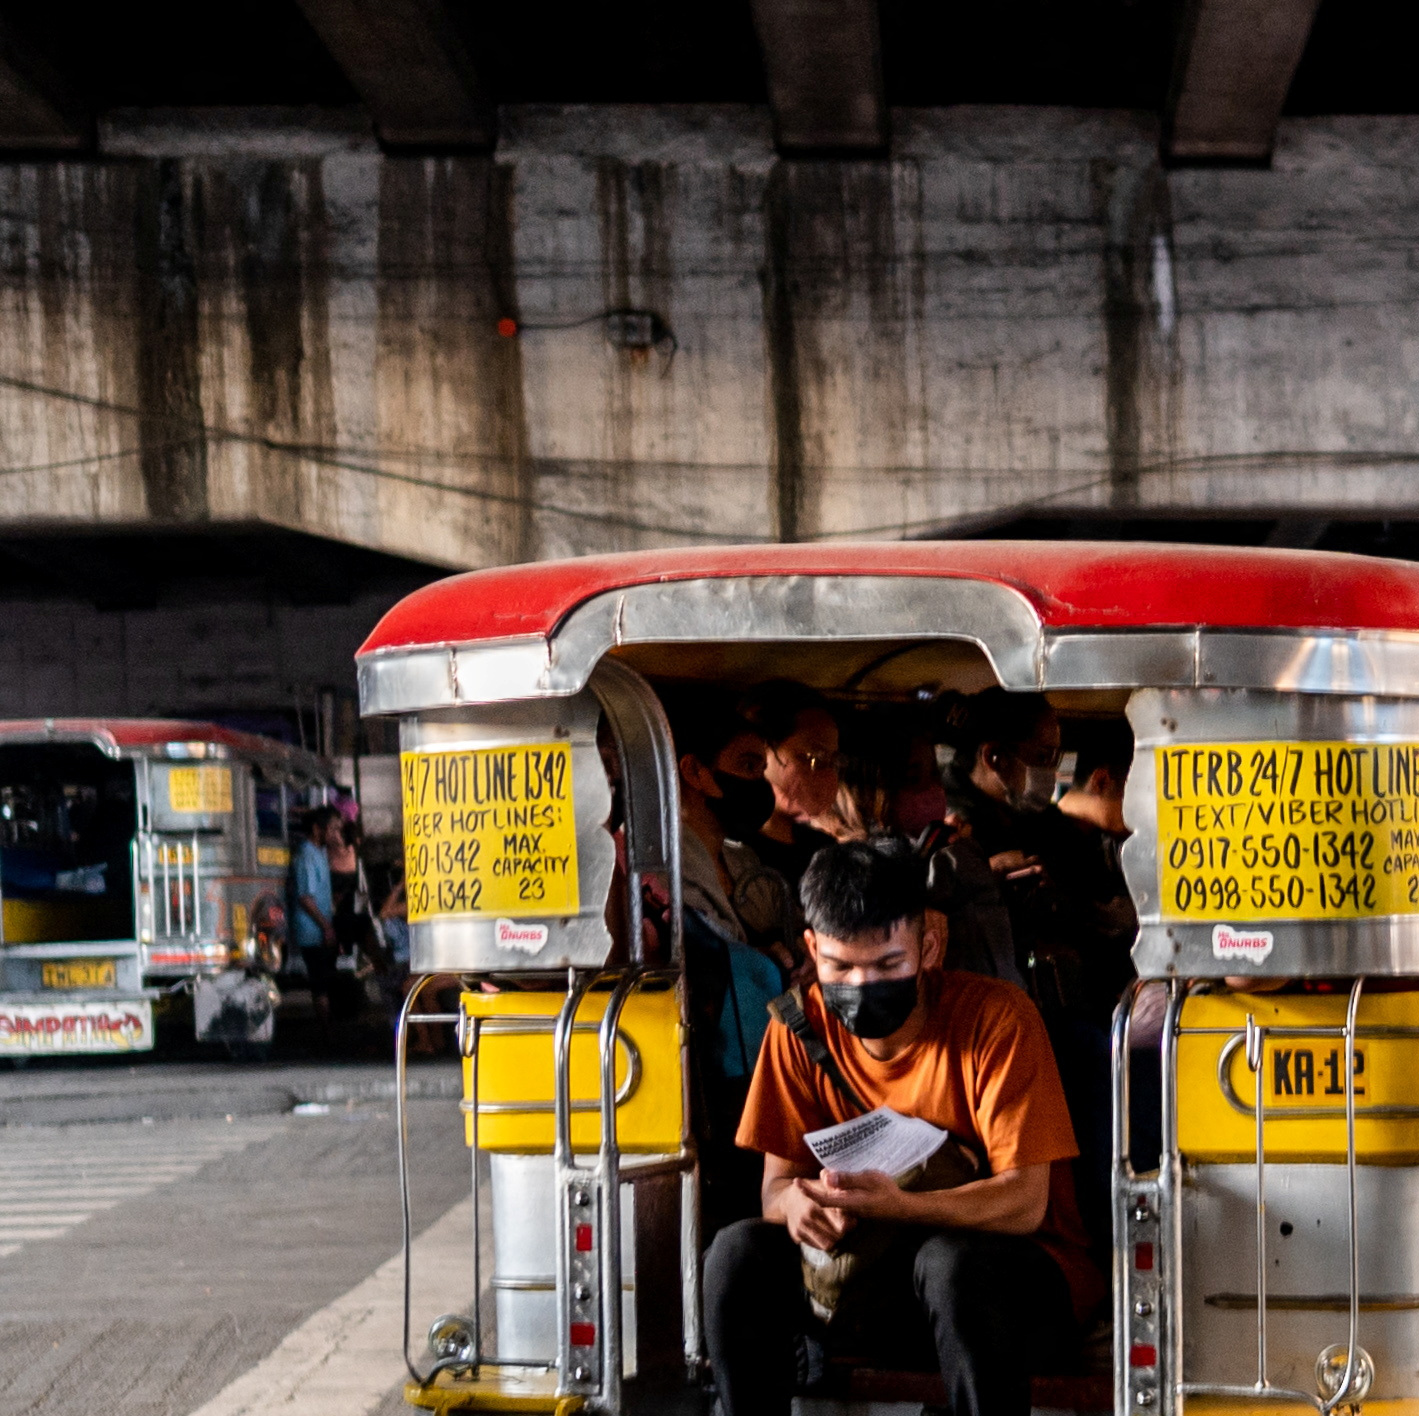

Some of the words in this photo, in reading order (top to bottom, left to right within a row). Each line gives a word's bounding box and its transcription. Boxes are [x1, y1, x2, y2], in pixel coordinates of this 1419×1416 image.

[435, 752, 518, 806] HOTLINE
[525, 750, 566, 802] 1342
[1162, 749, 1244, 800] LTFRB
[1250, 746, 1304, 799] 24/7
[450, 804, 563, 833] HOTLINES:
[1172, 799, 1344, 831] TEXT/VIBER
[503, 833, 546, 856] MAX.
[1169, 831, 1374, 869] 0917-550-1342
[493, 856, 569, 877] CAPACITY
[519, 877, 545, 900] 23
[1175, 873, 1377, 912] 0998-550-1342
[1274, 1048, 1365, 1096] KA-12
